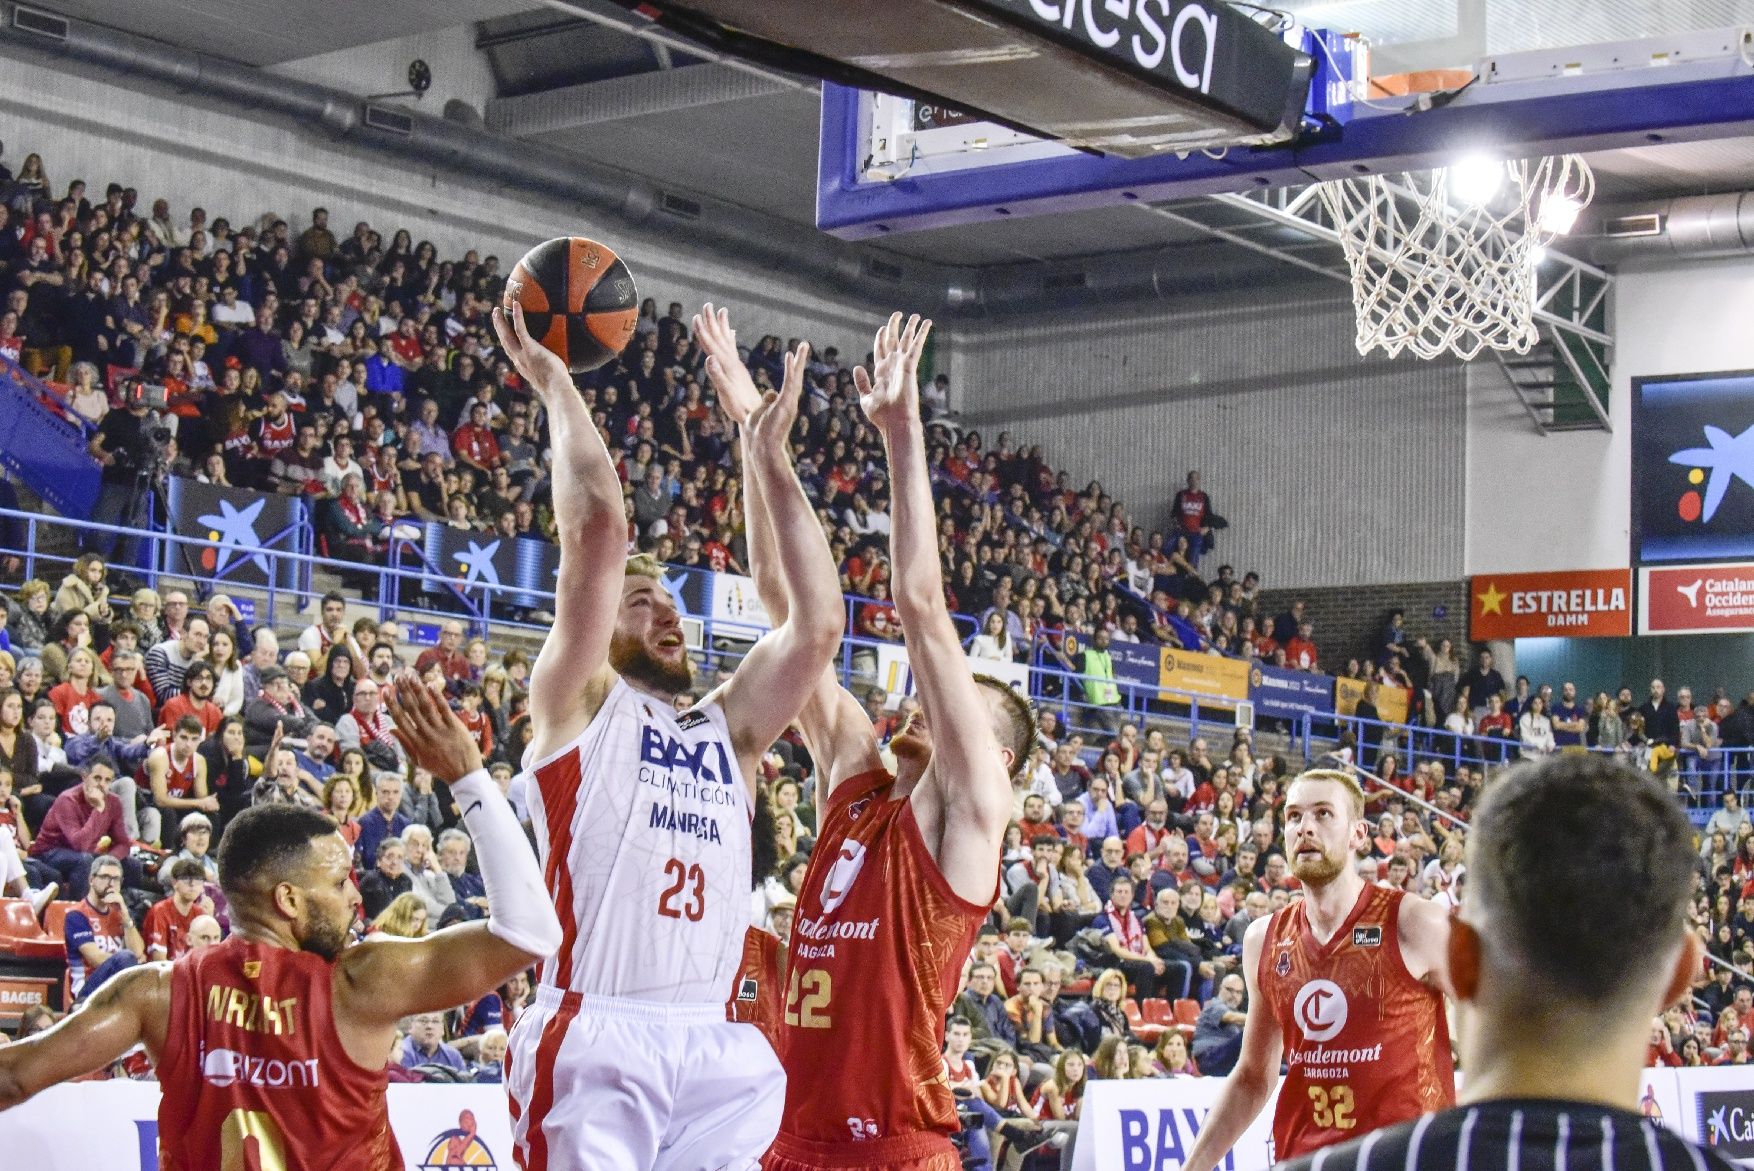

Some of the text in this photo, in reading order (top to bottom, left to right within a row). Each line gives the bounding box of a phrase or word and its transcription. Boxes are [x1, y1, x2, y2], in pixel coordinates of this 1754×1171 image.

[1511, 587, 1626, 615] ESTRELLA
[1547, 613, 1589, 627] DAMM
[641, 725, 733, 784] BAXI
[658, 858, 705, 922] 23
[3, 990, 43, 1005] BAGES
[1307, 1085, 1357, 1130] 32
